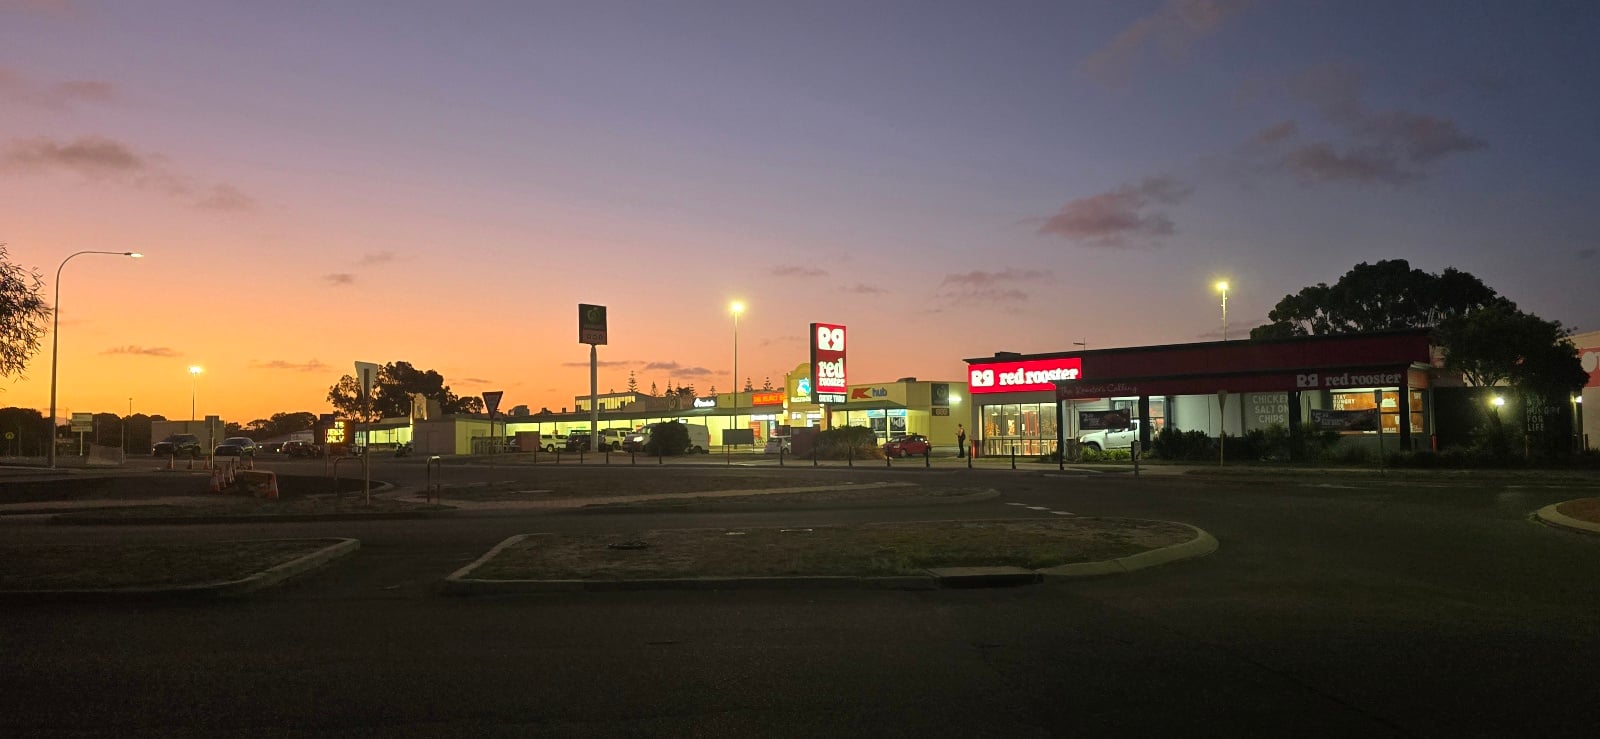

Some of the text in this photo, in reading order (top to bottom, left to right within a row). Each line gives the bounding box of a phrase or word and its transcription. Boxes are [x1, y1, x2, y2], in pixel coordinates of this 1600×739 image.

[818, 358, 844, 379] red
[999, 367, 1024, 386] red
[1025, 367, 1079, 384] rooster
[1325, 373, 1350, 387] red
[1351, 372, 1402, 386] rooster
[819, 378, 845, 388] rooster
[873, 386, 888, 397] hub
[1255, 405, 1276, 414] SALT
[1258, 414, 1284, 424] CHIPS
[1527, 415, 1544, 424] FOR
[1528, 423, 1545, 432] LIFE
